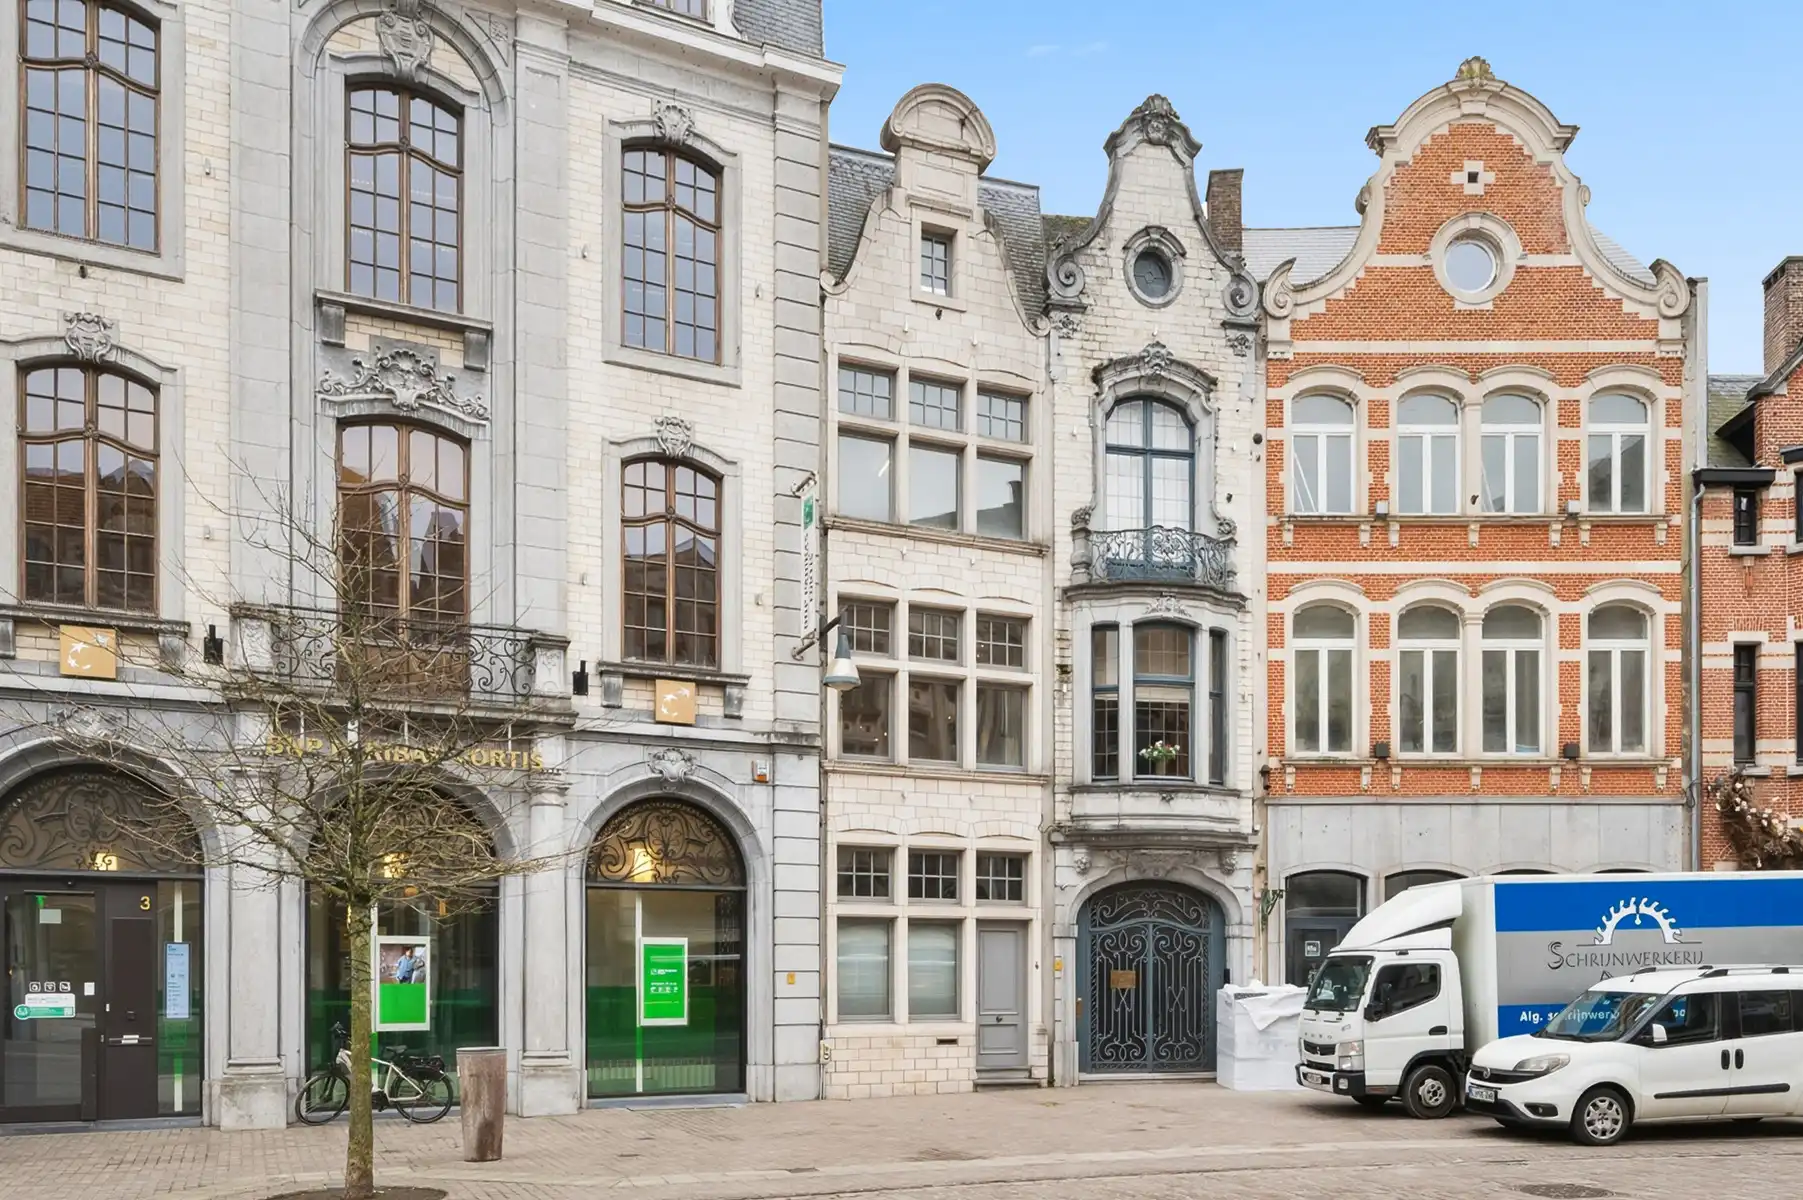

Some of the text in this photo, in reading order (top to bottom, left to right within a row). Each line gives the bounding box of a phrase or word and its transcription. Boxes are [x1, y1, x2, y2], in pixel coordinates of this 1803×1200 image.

[456, 746, 544, 772] ORTIS
[140, 896, 151, 910] 3
[1547, 941, 1704, 970] SCHRIJNWERKERIJ
[1519, 1010, 1543, 1024] Alg.
